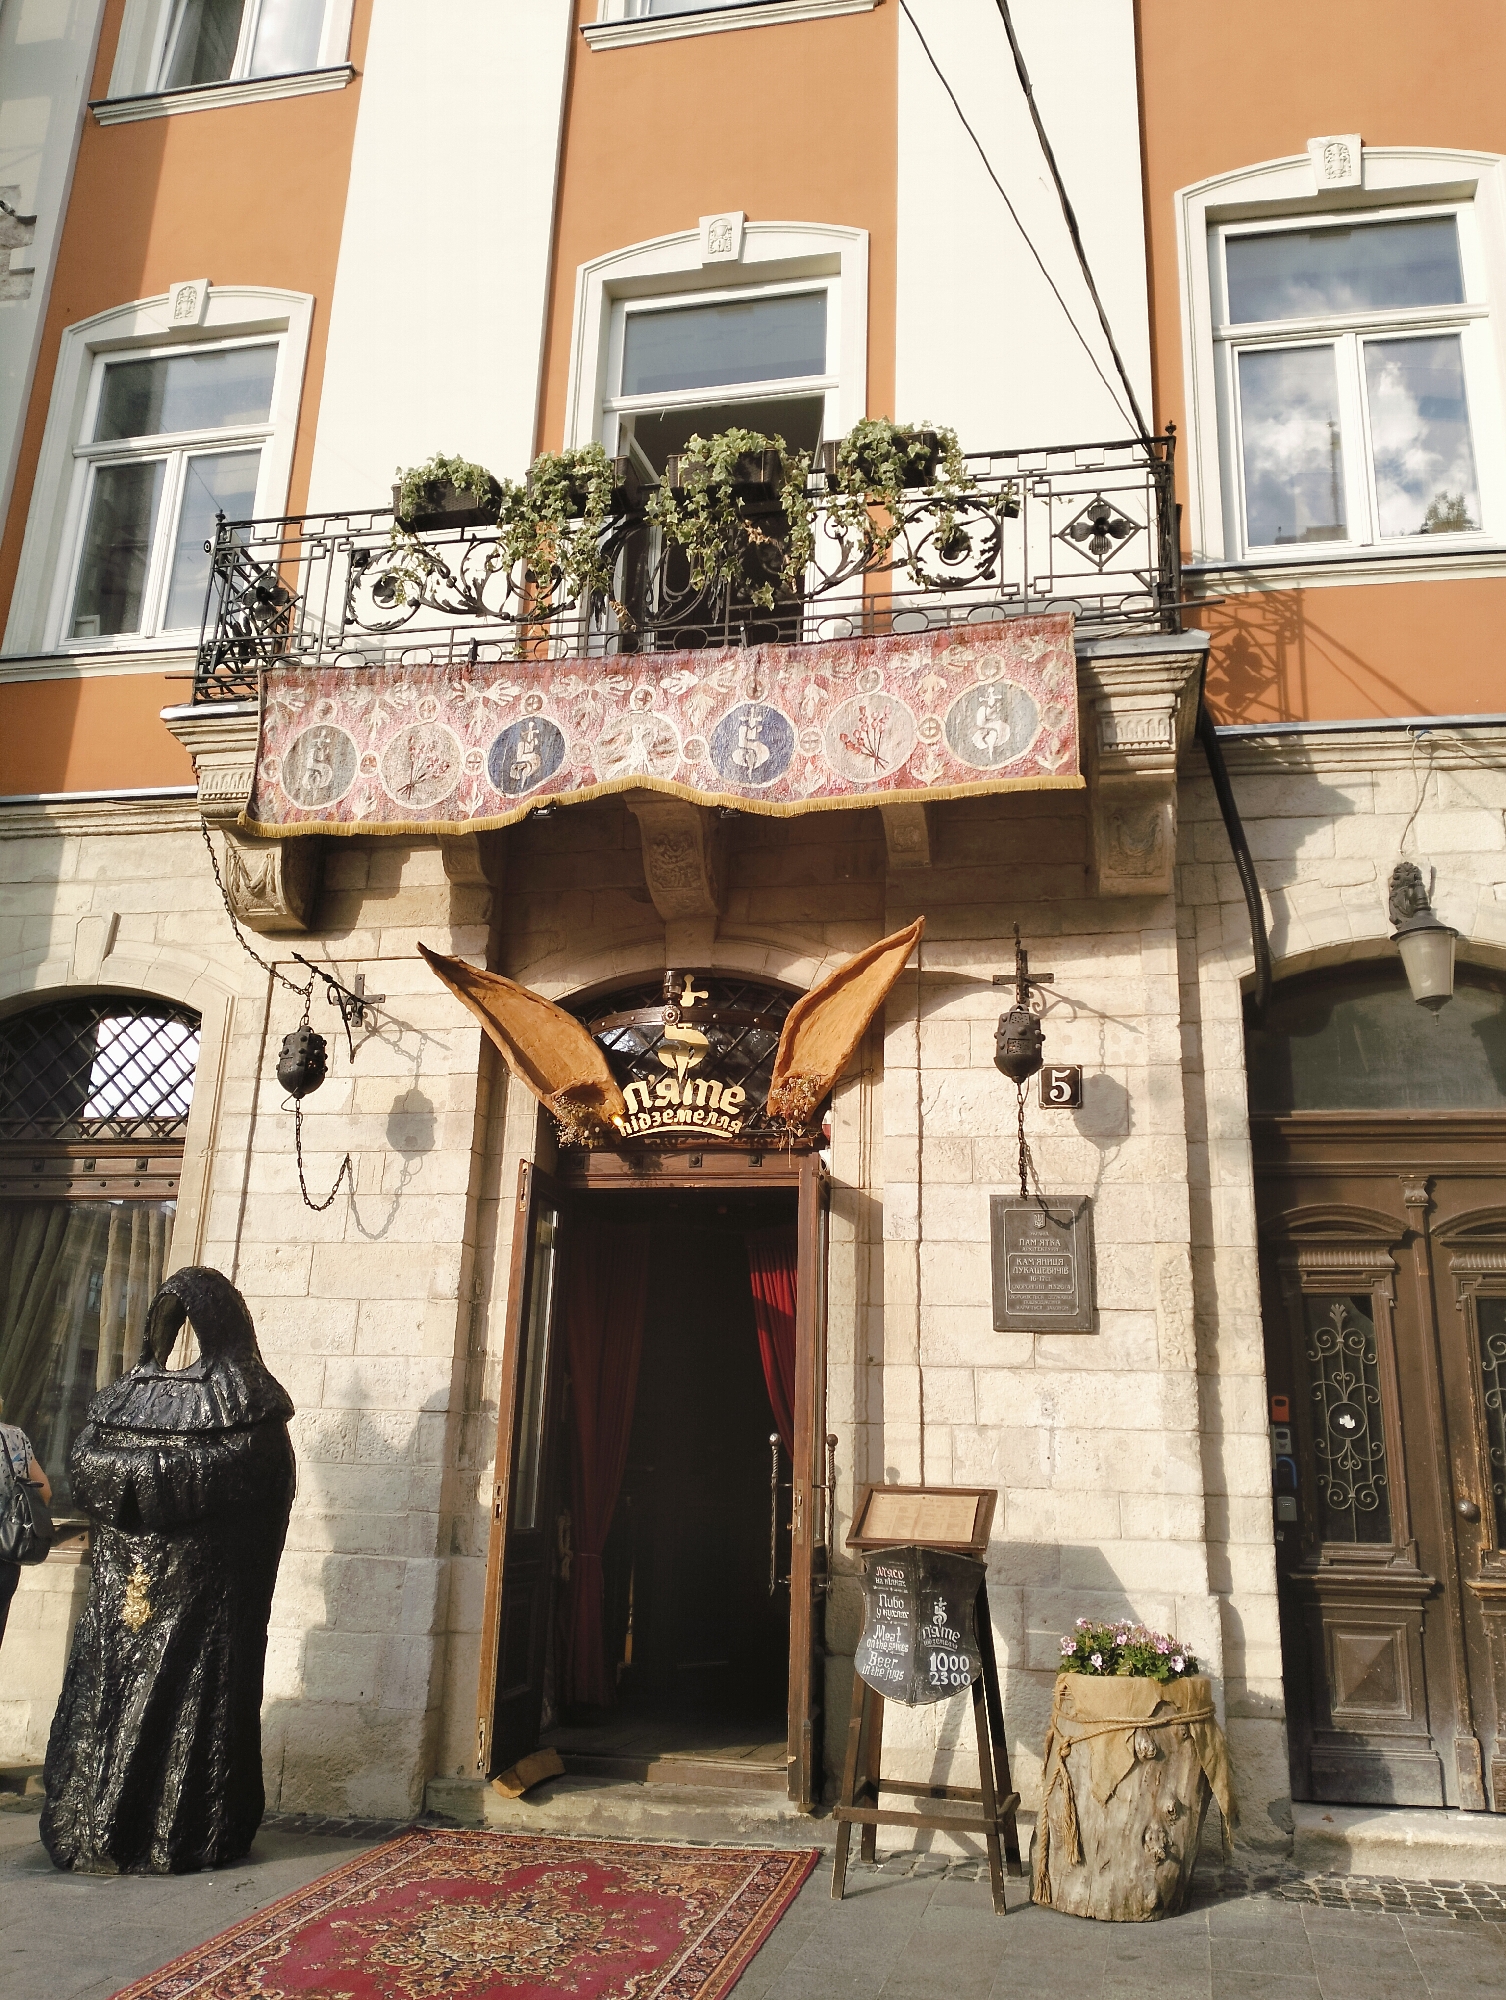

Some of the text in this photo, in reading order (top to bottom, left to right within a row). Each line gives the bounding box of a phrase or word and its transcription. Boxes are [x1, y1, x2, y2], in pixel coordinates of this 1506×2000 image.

[1049, 1069, 1072, 1102] 5
[1012, 1266, 1069, 1275] ЛУКАШЕВИЧІВ
[875, 1577, 884, 1585] на
[879, 1593, 905, 1609] Пиво
[872, 1624, 902, 1643] Meat
[866, 1638, 876, 1649] on
[875, 1639, 888, 1651] the
[868, 1650, 899, 1669] Beer
[861, 1664, 905, 1682] in the jugs
